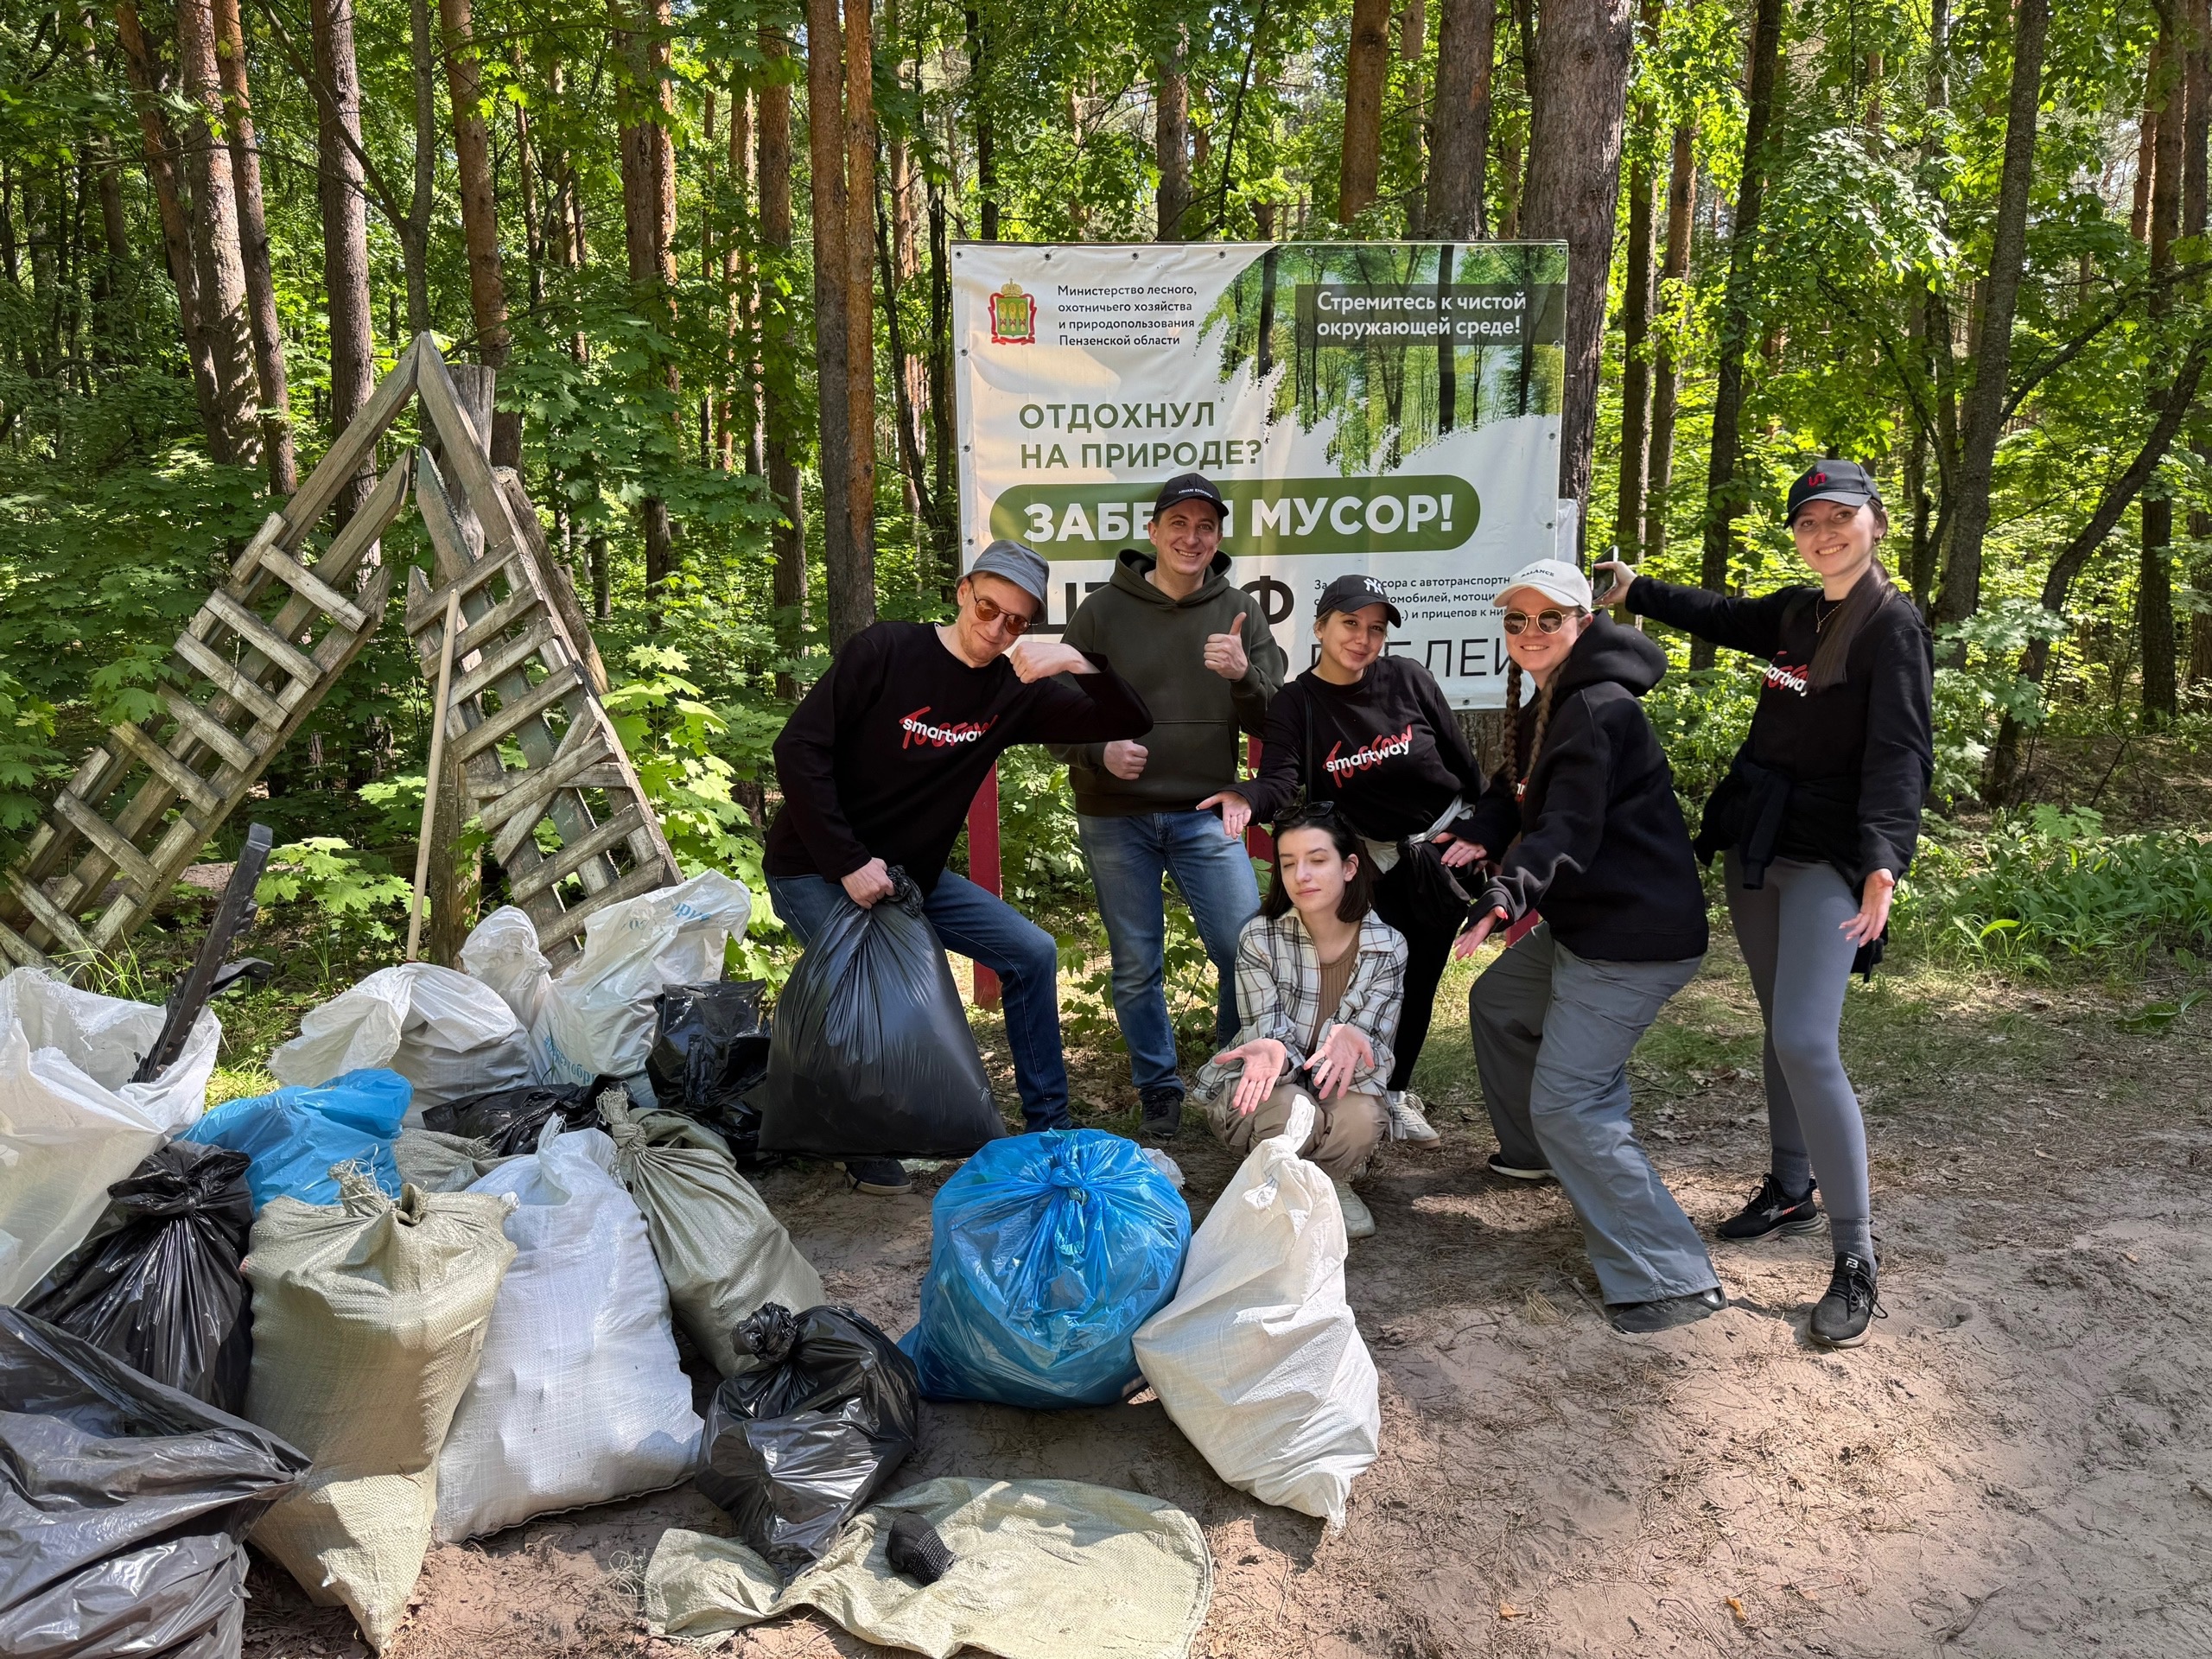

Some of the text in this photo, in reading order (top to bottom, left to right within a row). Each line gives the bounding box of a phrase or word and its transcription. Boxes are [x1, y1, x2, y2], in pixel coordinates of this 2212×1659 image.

[1058, 285, 1197, 297] Министерство лесного,
[1058, 301, 1192, 313] охотничьего хозяйства
[1317, 291, 1526, 315] Стремитесь к чистой
[1069, 320, 1195, 331] природопользования
[1317, 316, 1521, 340] окружающей среде!
[1059, 335, 1180, 346] Пензенской области
[1019, 401, 1215, 433] ОТДОХНУЛ
[1020, 439, 1262, 470] НА ПРИРОДЕ?
[1023, 493, 1453, 543] ЗАБЕ МУСОР!
[1381, 580, 1408, 590] сора
[1420, 575, 1510, 588] автотранспортн
[1453, 593, 1497, 602] мотоци
[1421, 608, 1477, 620] прицепов
[1326, 740, 1409, 772] smartway
